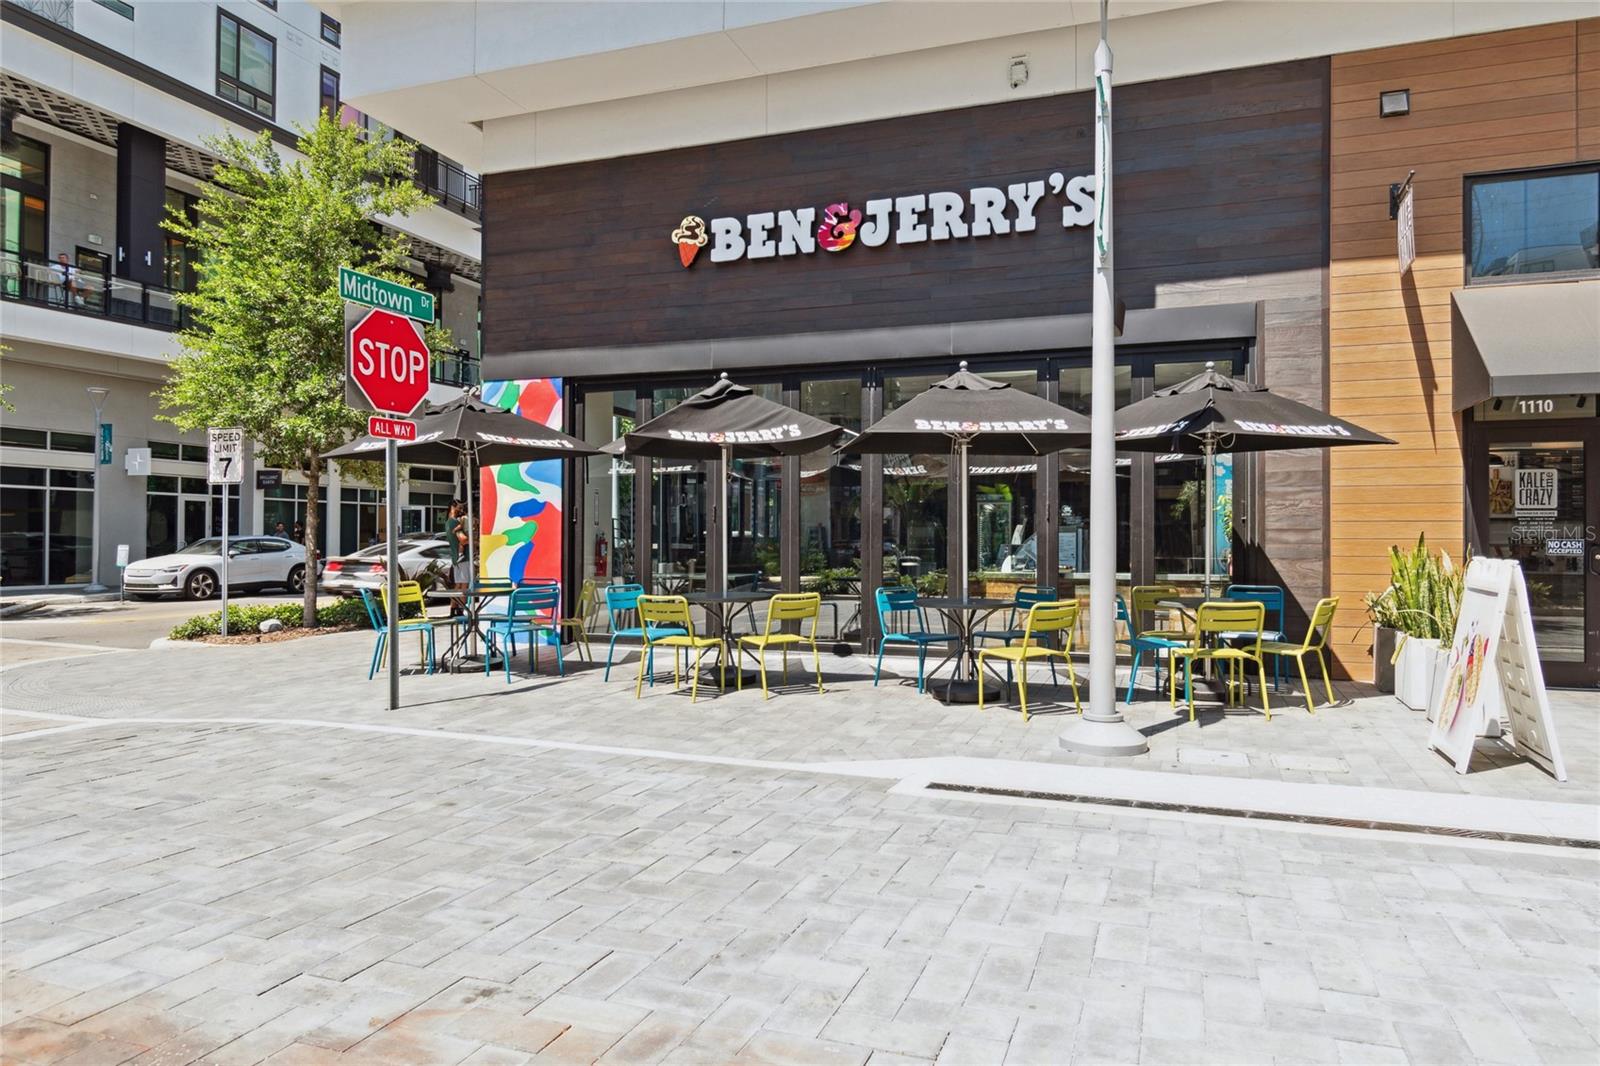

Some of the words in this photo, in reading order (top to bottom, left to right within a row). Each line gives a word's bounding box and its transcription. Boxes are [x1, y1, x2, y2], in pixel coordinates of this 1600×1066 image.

[344, 272, 413, 313] Midtown
[421, 296, 430, 308] Dr
[358, 338, 424, 385] STOP
[1519, 399, 1554, 414] 1110
[211, 432, 241, 442] SPEED
[374, 422, 391, 434] ALL
[393, 424, 411, 437] WAY
[214, 443, 237, 453] LIMIT
[219, 457, 232, 478] 7
[1519, 471, 1546, 488] KALE
[1519, 488, 1553, 506] CRAZY
[1547, 541, 1560, 549] NO
[1560, 541, 1582, 549] CASH
